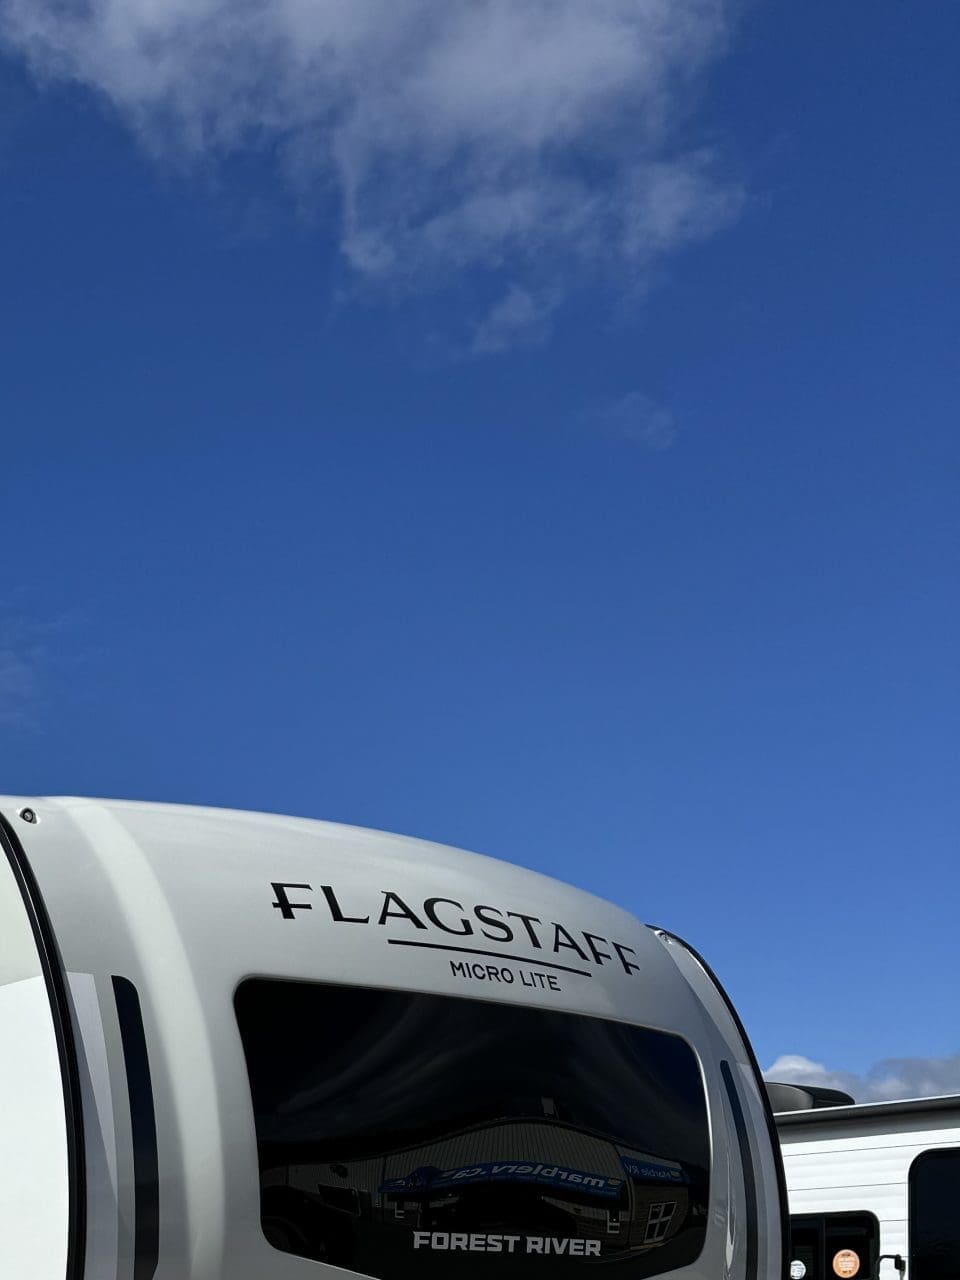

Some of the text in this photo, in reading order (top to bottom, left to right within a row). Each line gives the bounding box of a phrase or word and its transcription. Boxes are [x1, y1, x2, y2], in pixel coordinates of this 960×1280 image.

[271, 882, 640, 976] FLAGSTAFF
[449, 960, 561, 992] MICRO LITE
[413, 1231, 602, 1257] FOREST RIVER
